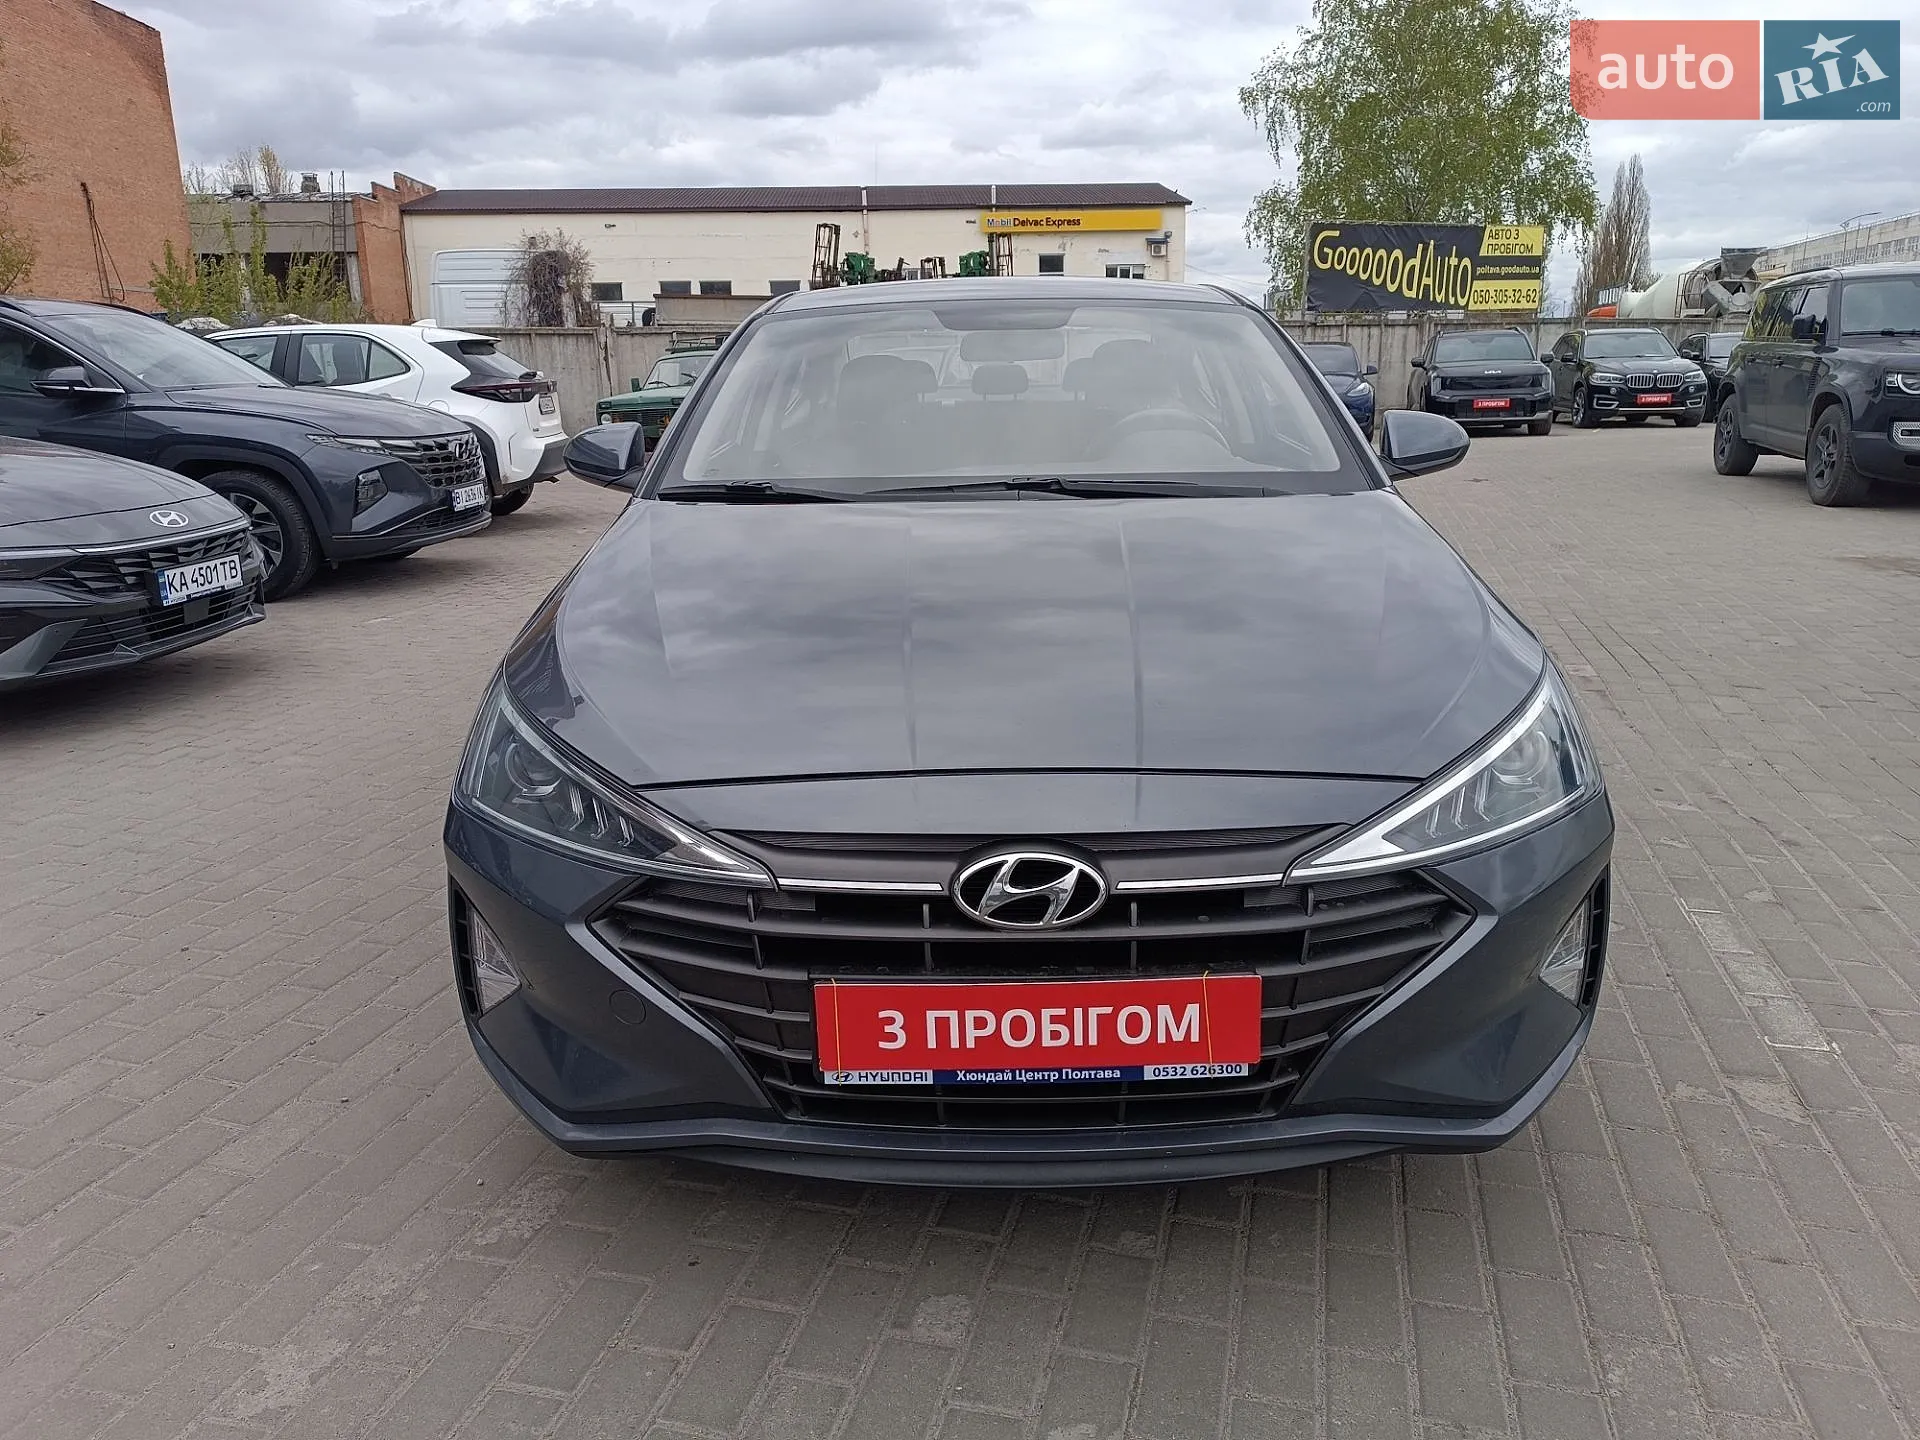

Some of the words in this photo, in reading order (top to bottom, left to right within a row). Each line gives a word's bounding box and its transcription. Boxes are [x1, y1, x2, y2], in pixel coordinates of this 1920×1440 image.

[1013, 218, 1043, 227] Delvac
[1045, 217, 1081, 228] Express
[1487, 228, 1512, 240] АВТО
[1486, 243, 1534, 254] ПРОБІГОМ
[1476, 264, 1540, 276] poltava.goodauto.ua
[1472, 288, 1538, 304] 050-305-32-62
[166, 571, 189, 595] KA
[190, 563, 220, 588] 4501
[220, 559, 239, 581] TB
[925, 1003, 1200, 1049] ПРОБІГОМ
[858, 1071, 928, 1082] HYUNDAI
[956, 1069, 1013, 1083] Хюндай
[1015, 1068, 1059, 1082] Центр
[1062, 1068, 1121, 1080] Полтава
[1152, 1066, 1188, 1077] 0532
[1190, 1063, 1243, 1076] 626300
